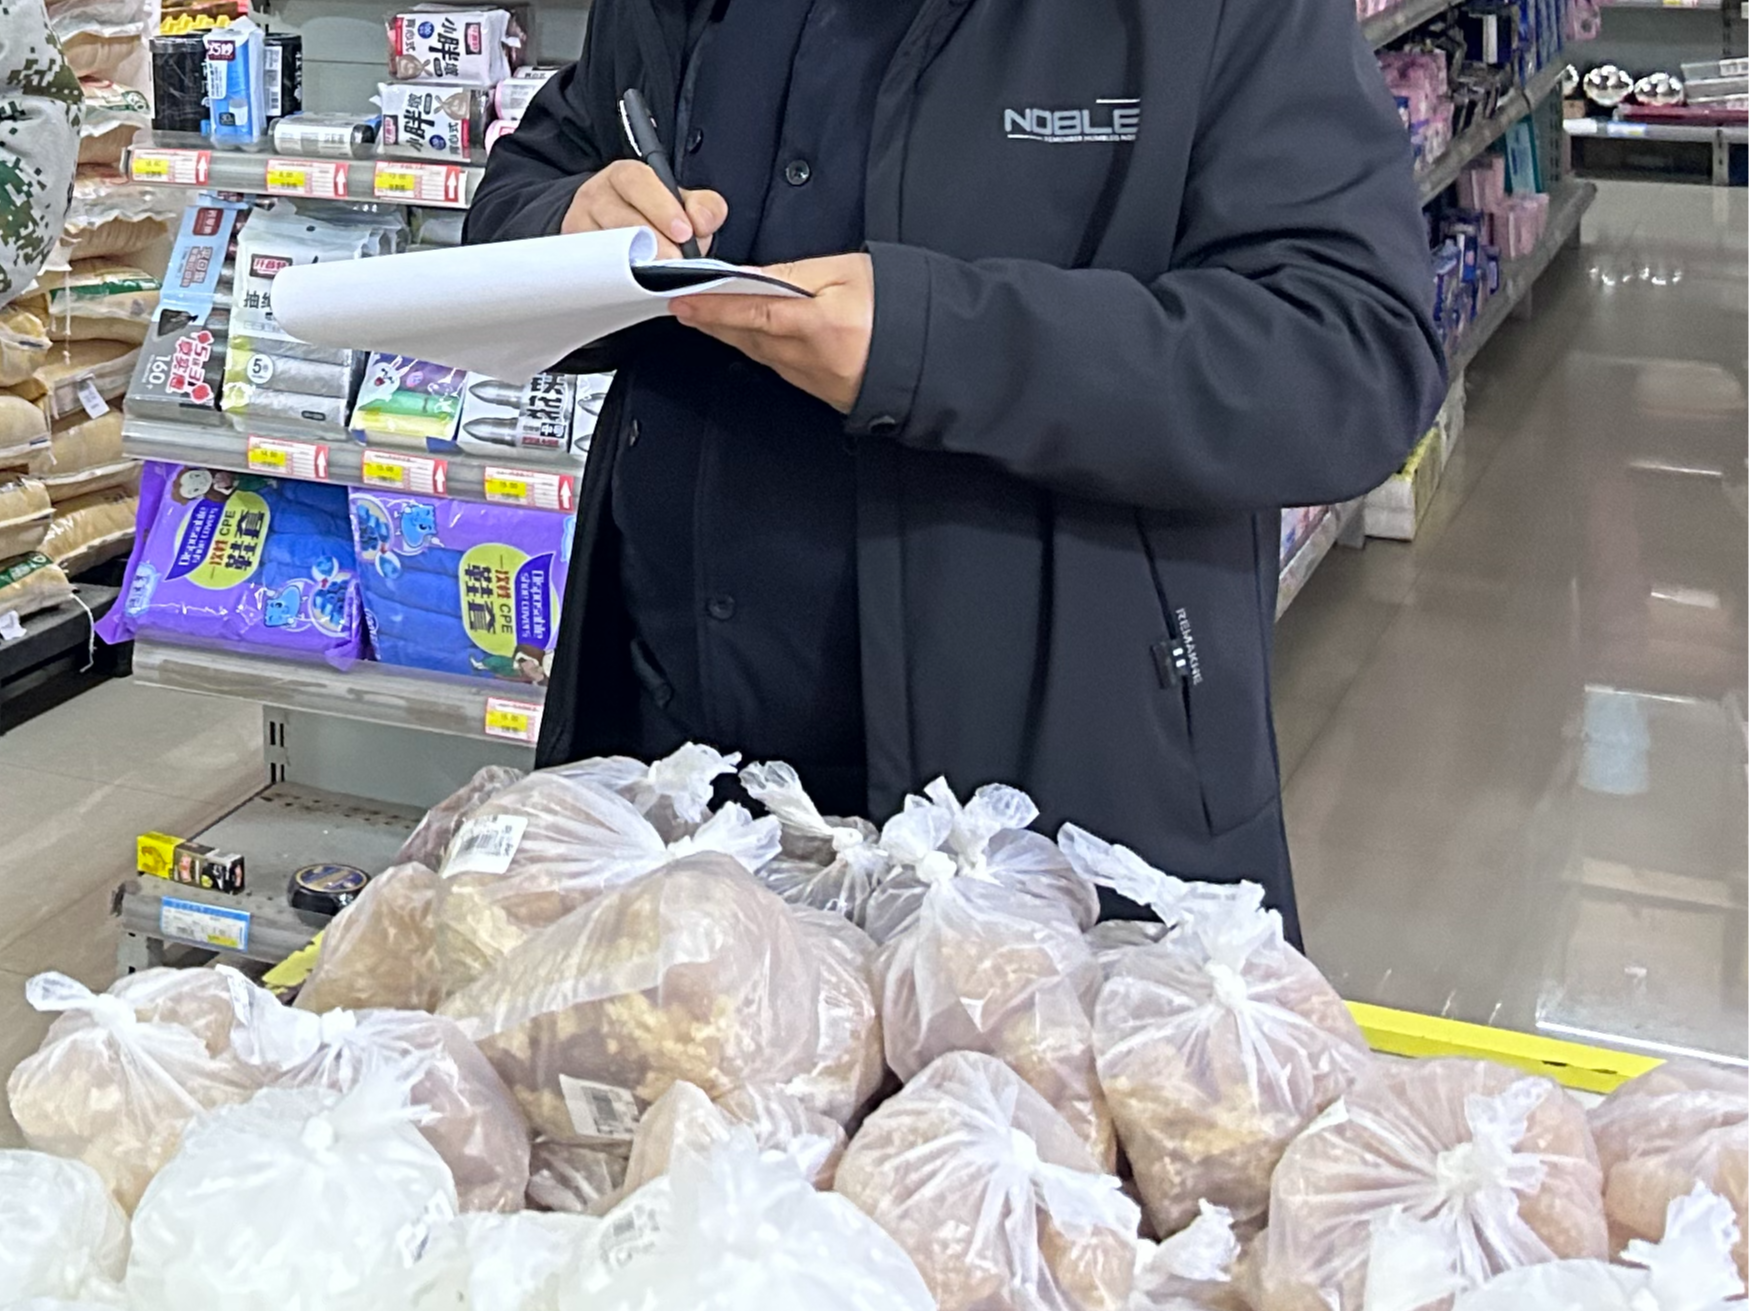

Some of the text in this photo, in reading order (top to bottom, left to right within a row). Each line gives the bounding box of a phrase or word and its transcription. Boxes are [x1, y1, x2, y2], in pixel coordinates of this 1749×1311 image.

[1004, 107, 1140, 135] NOBLE
[219, 510, 236, 536] CPE
[499, 603, 512, 634] CPE
